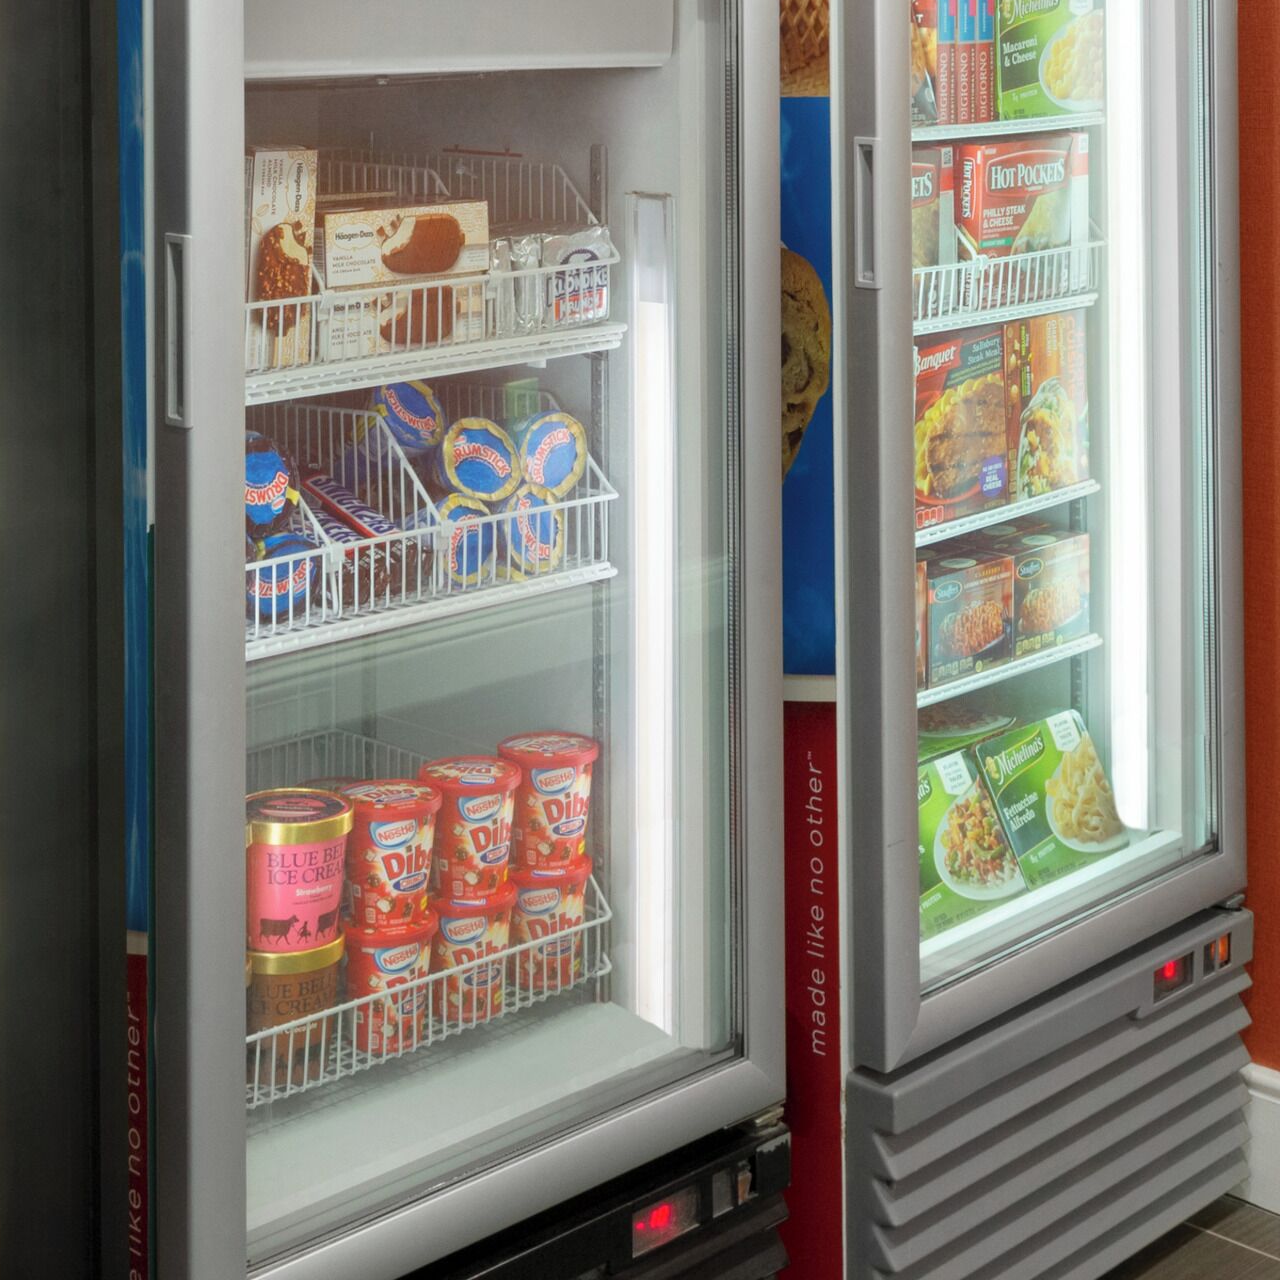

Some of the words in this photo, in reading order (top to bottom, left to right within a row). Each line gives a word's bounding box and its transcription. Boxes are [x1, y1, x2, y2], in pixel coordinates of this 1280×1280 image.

[1002, 35, 1038, 55] Macaroni
[1003, 57, 1011, 68] &
[1011, 50, 1038, 66] Cheese
[939, 52, 948, 121] DIGIORNO
[959, 52, 969, 120] DIGIORNO
[979, 51, 988, 119] DIGIORNO
[962, 160, 973, 187] HOT
[990, 165, 1016, 191] HOT
[1017, 157, 1065, 187] POCKETS
[961, 187, 972, 219] POCKETS
[982, 207, 1005, 219] PHILLY
[1006, 204, 1026, 215] STEAK
[334, 229, 375, 242] Häagen-Dazs
[982, 219, 989, 229] &
[989, 216, 1014, 228] CHEESE
[913, 344, 957, 376] Banquet
[245, 470, 289, 505] DRUMST
[982, 480, 1002, 492] CHEESE
[985, 472, 1000, 483] REAL
[995, 736, 1044, 786] Michelina's
[543, 791, 590, 825] Dibs
[804, 760, 824, 847] other
[1003, 791, 1039, 821] Fettuccine
[469, 819, 512, 854] Dib
[1009, 808, 1036, 833] Alfredo
[266, 850, 318, 869] BLUE
[322, 842, 345, 864] BEL
[381, 844, 433, 880] Dibs
[266, 869, 298, 886] ICE
[295, 883, 334, 898] Strawberry
[807, 857, 825, 896] no
[806, 904, 826, 958] like
[807, 967, 828, 1056] made
[127, 1127, 142, 1177] no
[127, 1189, 142, 1257] like
